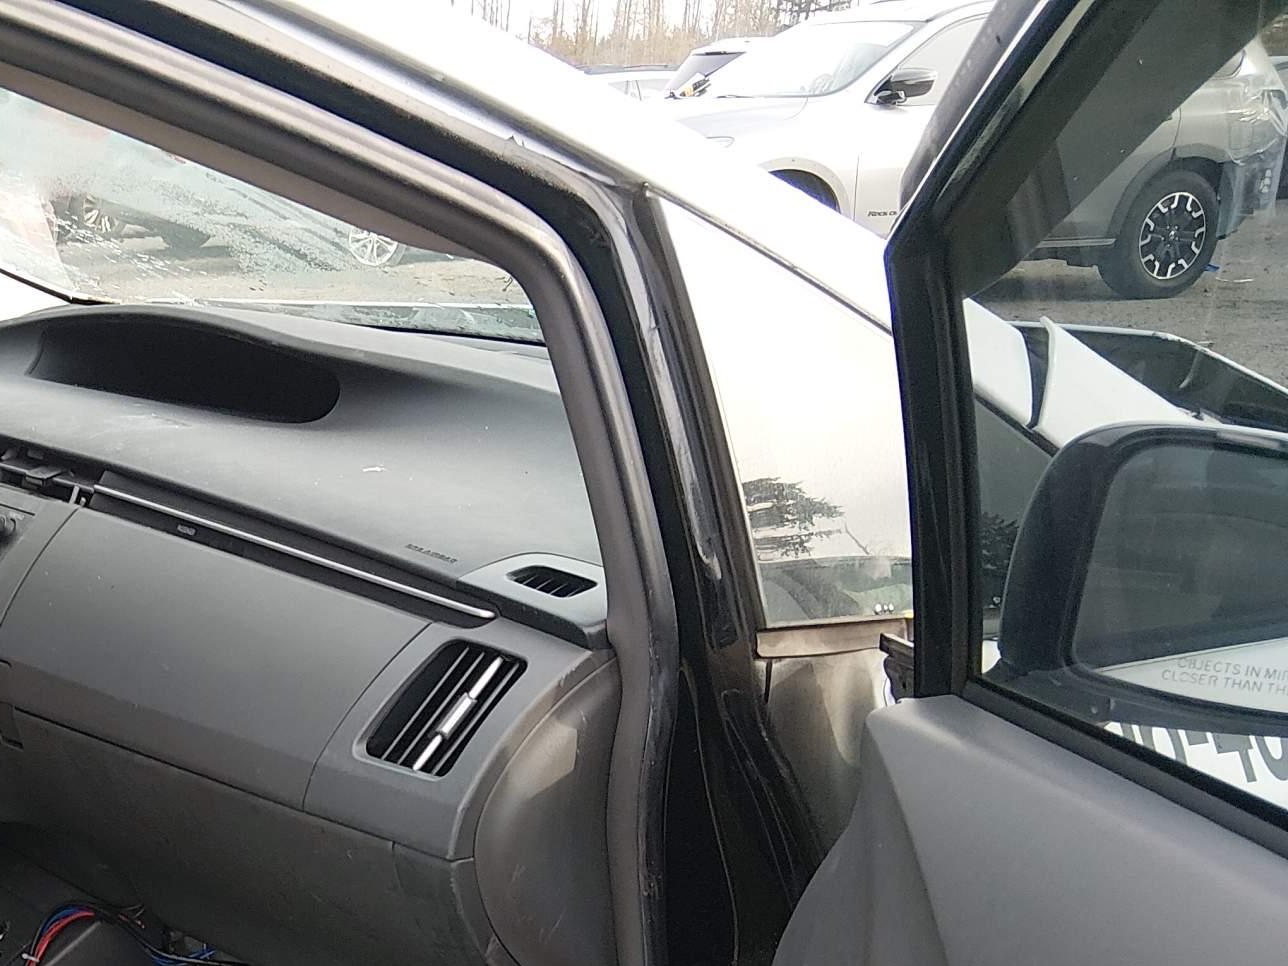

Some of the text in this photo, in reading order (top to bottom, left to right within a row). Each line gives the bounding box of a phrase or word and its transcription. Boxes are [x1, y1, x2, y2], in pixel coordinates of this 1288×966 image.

[1177, 657, 1241, 676] OBJECTS
[1245, 665, 1262, 678] IN
[1161, 669, 1288, 696] CLOSER THAN TH
